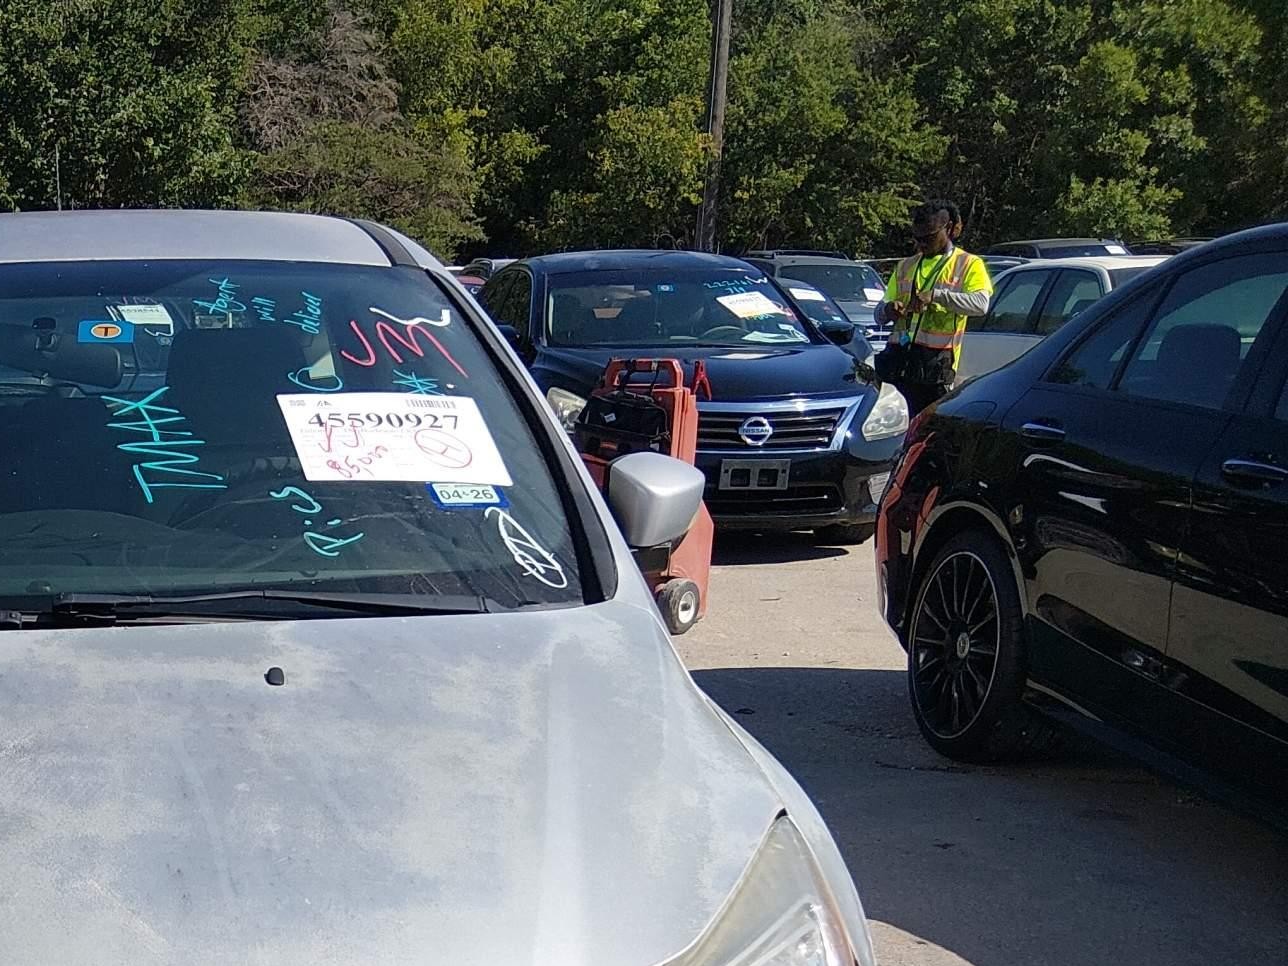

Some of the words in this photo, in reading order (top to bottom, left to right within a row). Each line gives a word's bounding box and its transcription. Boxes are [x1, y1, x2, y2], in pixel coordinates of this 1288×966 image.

[308, 412, 458, 430] 45590927
[439, 489, 463, 500] 04
[470, 489, 494, 499] 26
